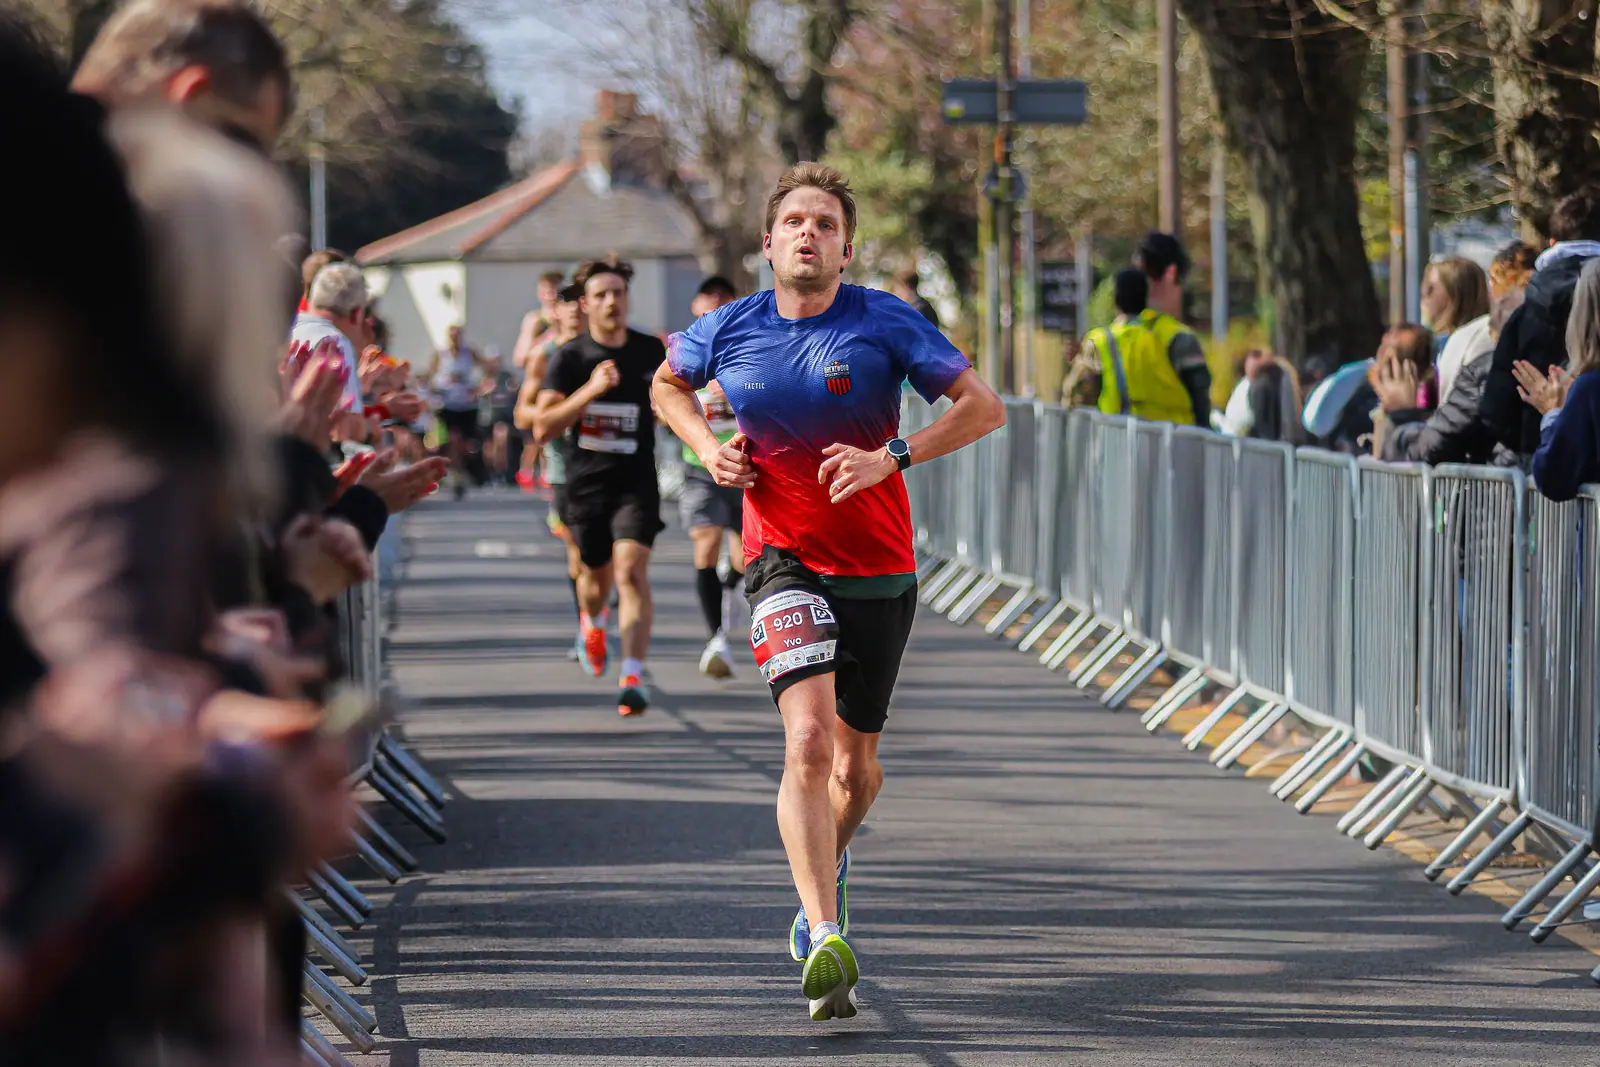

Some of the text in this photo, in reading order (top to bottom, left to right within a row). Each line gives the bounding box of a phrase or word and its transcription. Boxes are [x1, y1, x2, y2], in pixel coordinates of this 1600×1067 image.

[744, 382, 765, 390] TACTIC
[773, 612, 803, 632] 920
[783, 637, 802, 648] Yvo
